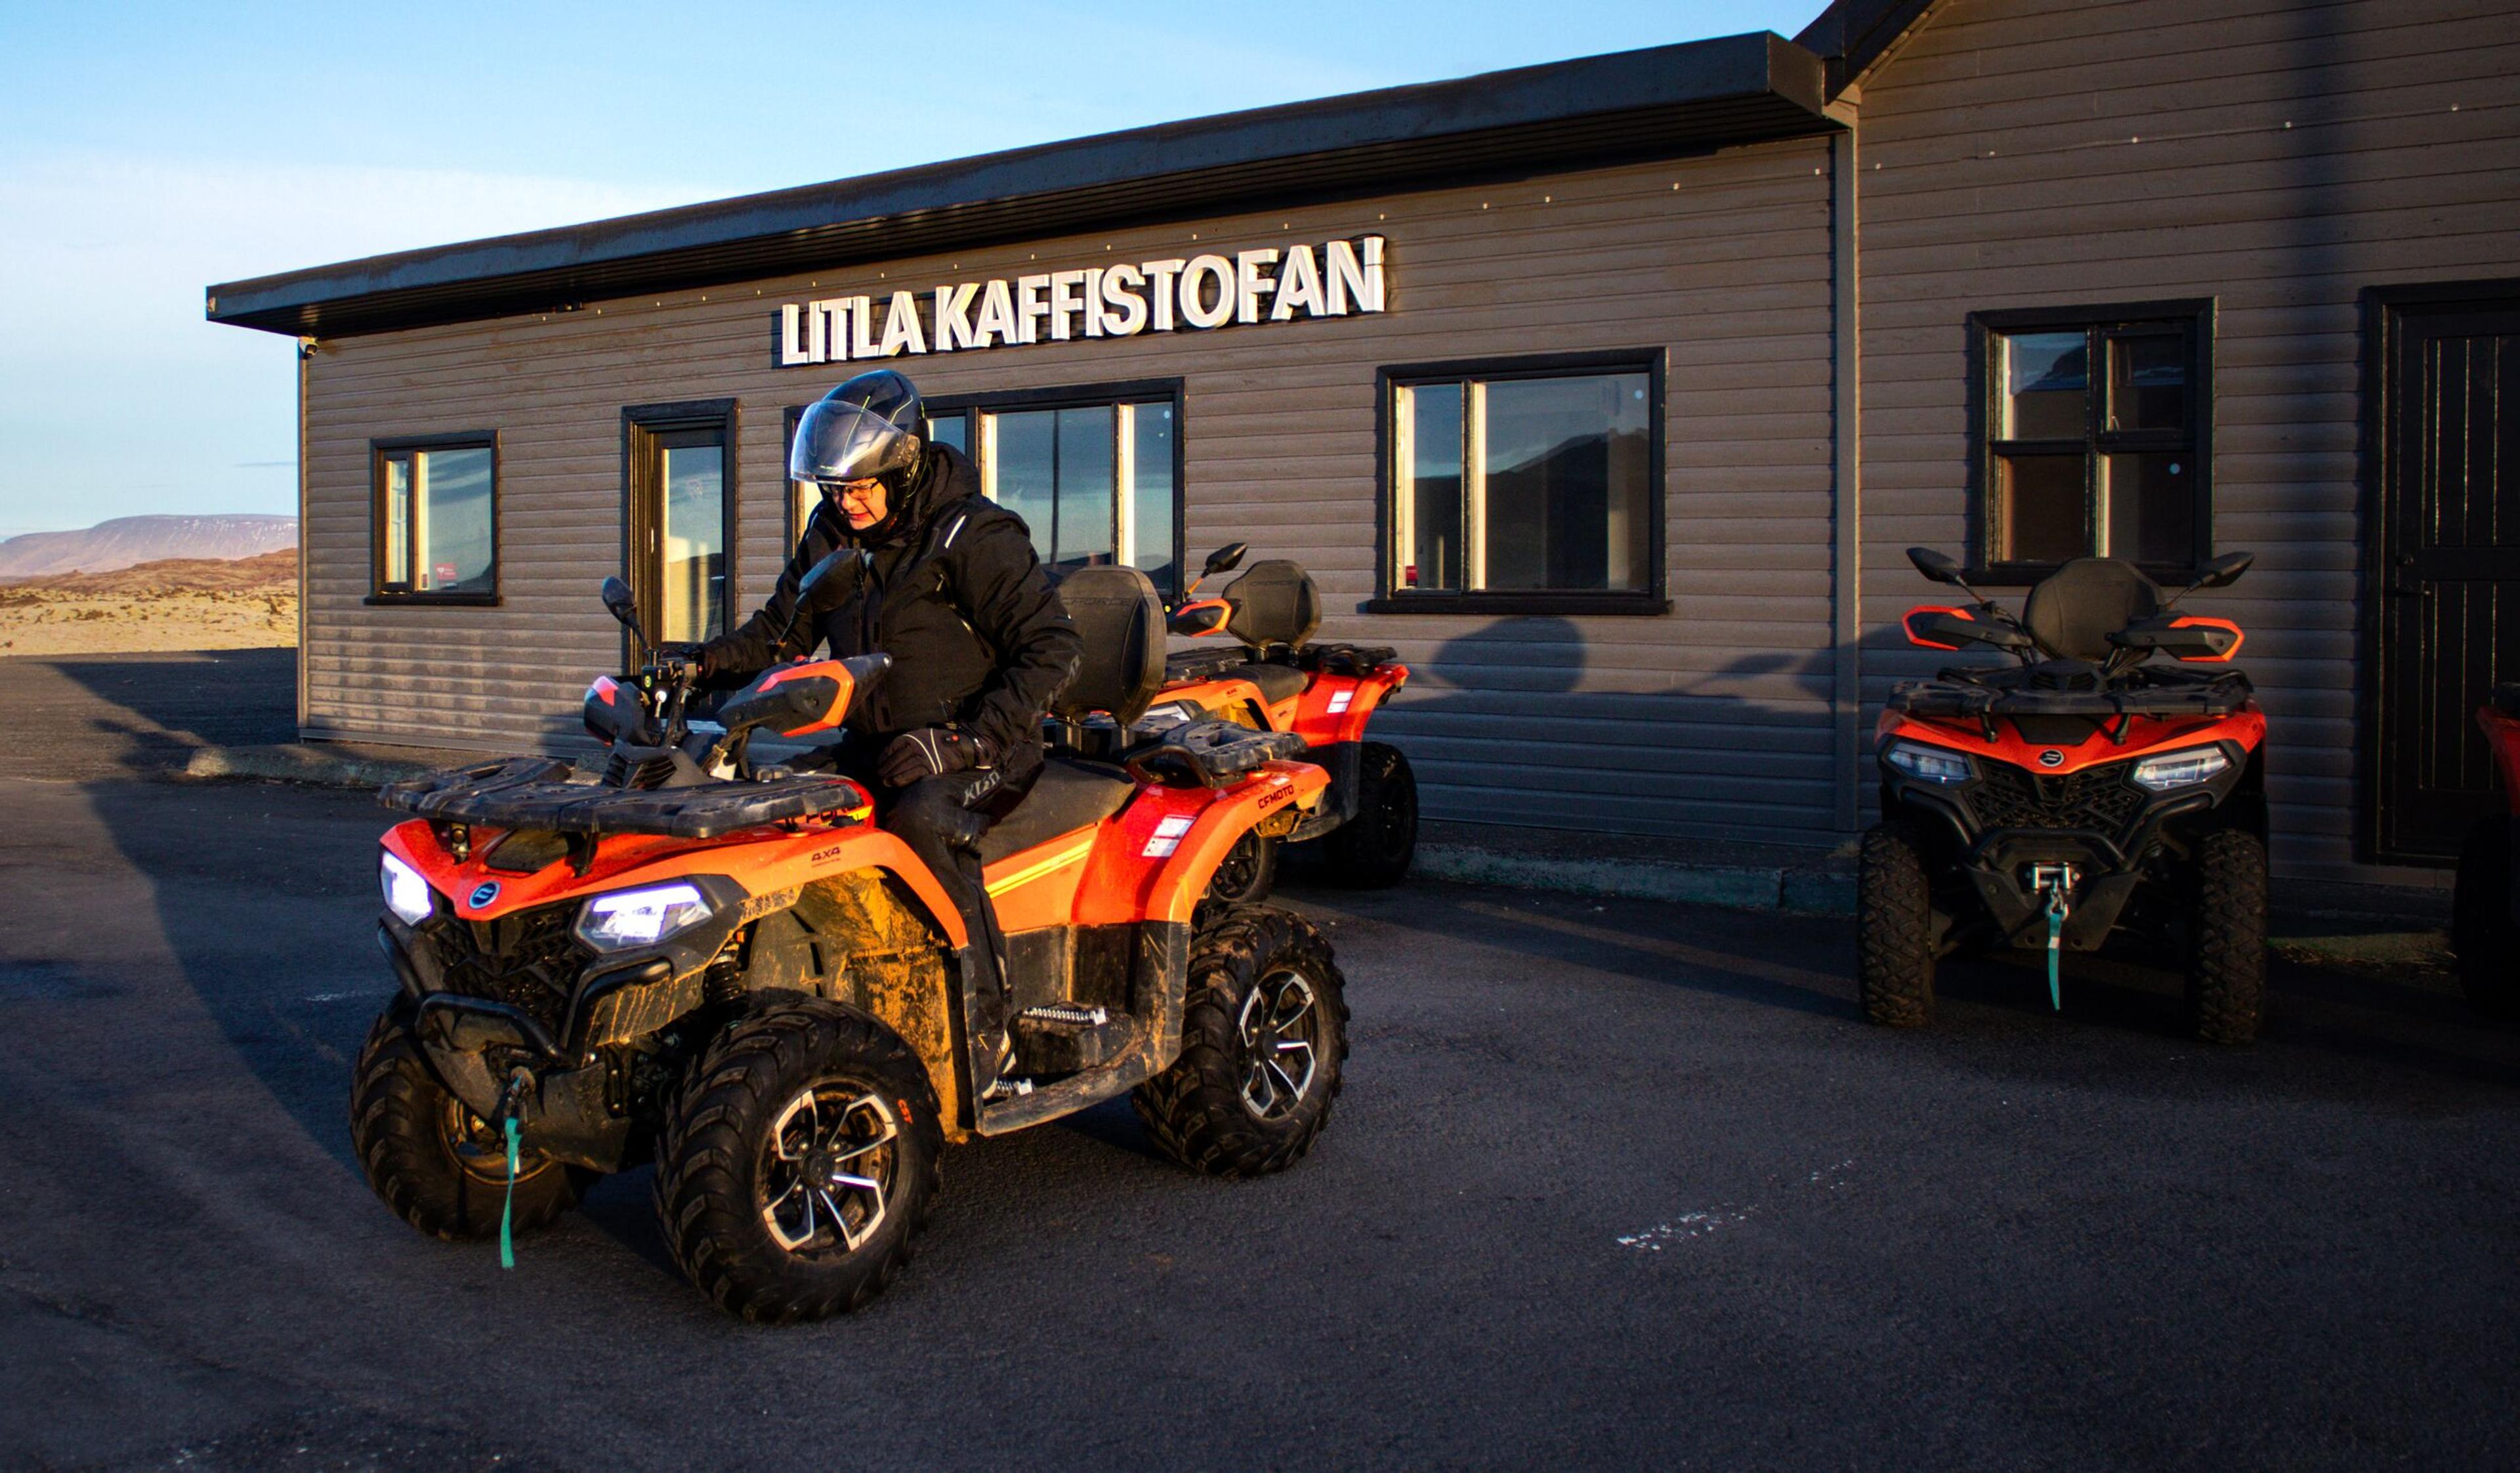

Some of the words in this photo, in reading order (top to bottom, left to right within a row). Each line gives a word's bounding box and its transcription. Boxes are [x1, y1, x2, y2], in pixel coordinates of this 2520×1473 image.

[782, 290, 926, 364] LITLA
[935, 236, 1385, 351] KAFFISTOFAN
[1258, 784, 1294, 809] CFMOTO
